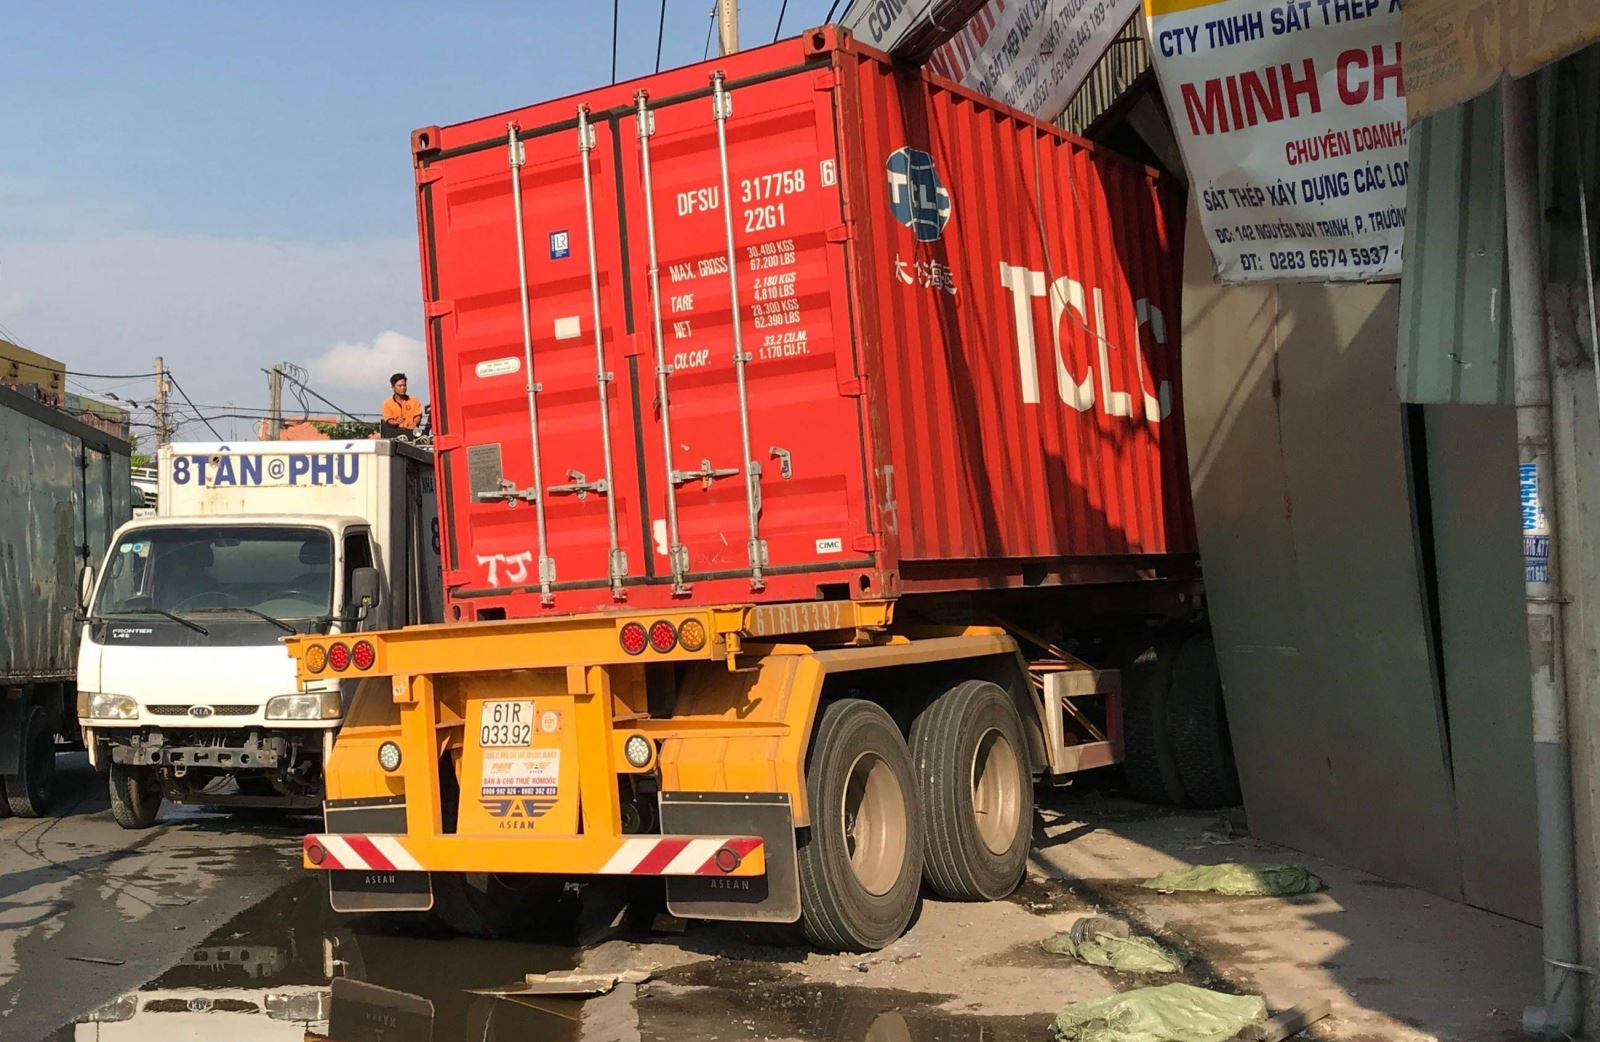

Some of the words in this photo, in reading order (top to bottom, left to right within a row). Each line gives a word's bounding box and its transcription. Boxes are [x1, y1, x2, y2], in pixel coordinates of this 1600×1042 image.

[1089, 2, 1104, 31] 189
[1159, 24, 1199, 58] CTY
[1205, 10, 1264, 50] TNHH
[1180, 57, 1322, 136] MINH
[1285, 128, 1351, 166] CHUYÊN
[1352, 121, 1407, 153] DOANH:
[677, 186, 719, 217] DFSU
[740, 168, 806, 203] 317758
[822, 161, 834, 186] 6
[1228, 182, 1265, 208] THÉP
[1266, 178, 1297, 206] XÂY
[1301, 172, 1350, 206] DỰNG
[1353, 160, 1386, 192] CÁC
[744, 203, 786, 233] 22G1
[1235, 224, 1256, 241] 142
[1295, 222, 1317, 238] DUY
[746, 242, 776, 258] 30.480
[777, 239, 795, 252] KGS
[1240, 253, 1263, 271] ĐT:
[1269, 250, 1305, 271] 0283
[1309, 249, 1347, 268] 6674
[1350, 245, 1389, 266] 5937
[669, 264, 697, 283] MAX.
[697, 256, 729, 278] GROSS
[750, 256, 779, 271] 67.200
[780, 252, 796, 265] LBS
[754, 274, 779, 289] 2.180
[779, 272, 797, 283] KGS
[754, 287, 778, 301] 4.810
[779, 284, 795, 297] LBS
[671, 293, 695, 313] TARE
[751, 301, 781, 316] 28.300
[782, 299, 799, 312] KGS
[673, 320, 692, 339] NET
[754, 313, 783, 329] 62.390
[784, 311, 800, 324] LBS
[759, 346, 781, 361] 1.170
[819, 541, 840, 549] CIMC
[192, 708, 209, 716] KIA
[493, 703, 521, 723] 61R
[481, 725, 530, 745] 033.92
[499, 821, 534, 829] ASEAN
[365, 875, 395, 884] ASEAN
[711, 879, 749, 889] ASEAN
